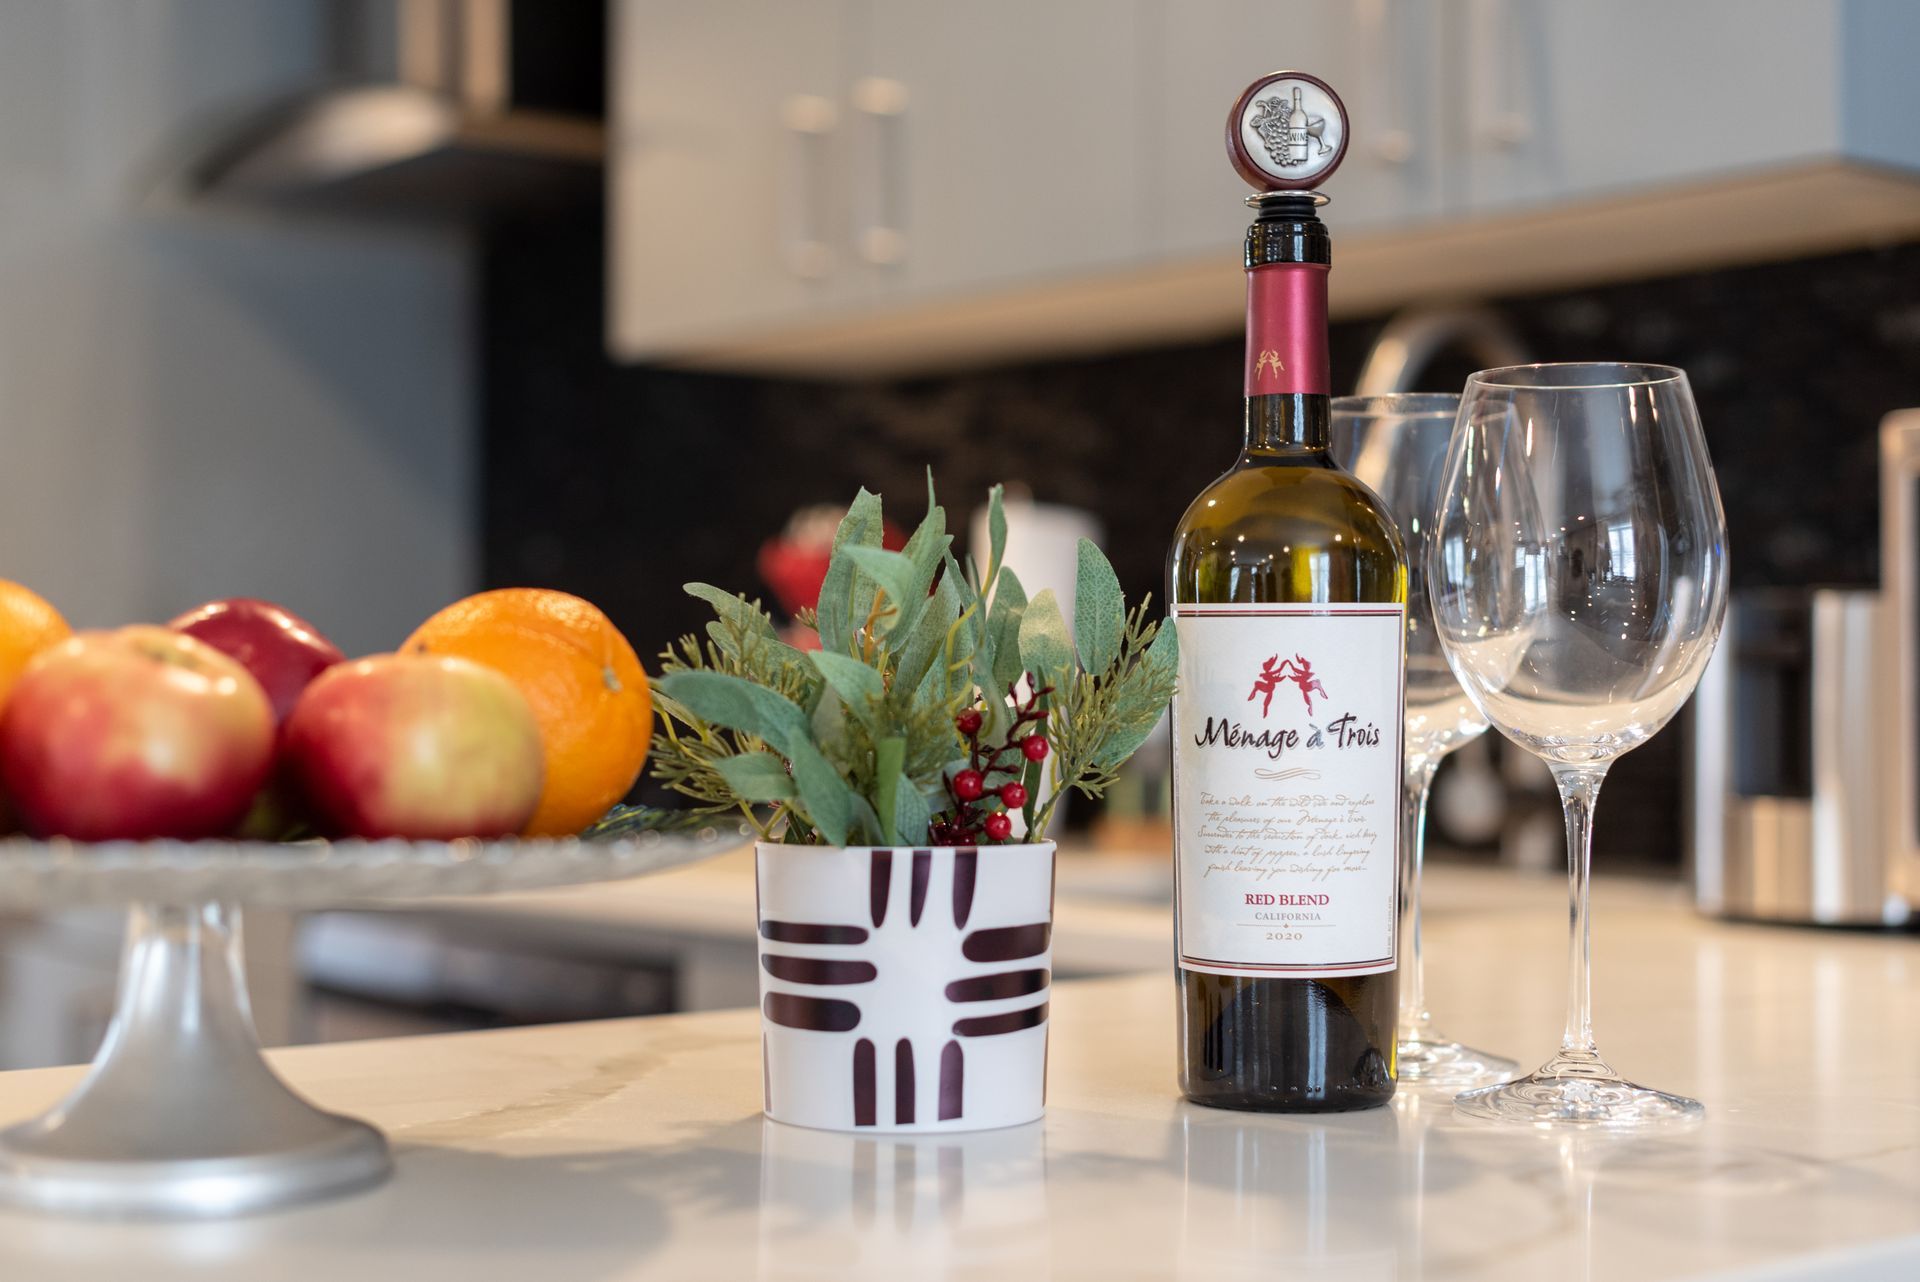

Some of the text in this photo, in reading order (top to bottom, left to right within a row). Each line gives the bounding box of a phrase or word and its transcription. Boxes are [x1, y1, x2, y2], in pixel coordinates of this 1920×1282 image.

[1195, 712, 1380, 761] Ménage à Trois
[1200, 791, 1219, 806] Take
[1229, 795, 1254, 807] walk
[1266, 796, 1288, 807] the
[1330, 794, 1349, 806] and
[1348, 793, 1374, 810] explore
[1205, 811, 1223, 822] the
[1312, 844, 1334, 857] lush
[1335, 844, 1370, 864] lingering
[1234, 860, 1267, 881] leaving
[1267, 867, 1286, 880] you
[1290, 863, 1323, 881] wishing
[1321, 865, 1340, 881] for
[1245, 893, 1330, 906] RED BLEND
[1255, 912, 1321, 921] CALIFORNIA
[1266, 932, 1303, 941] 2020
